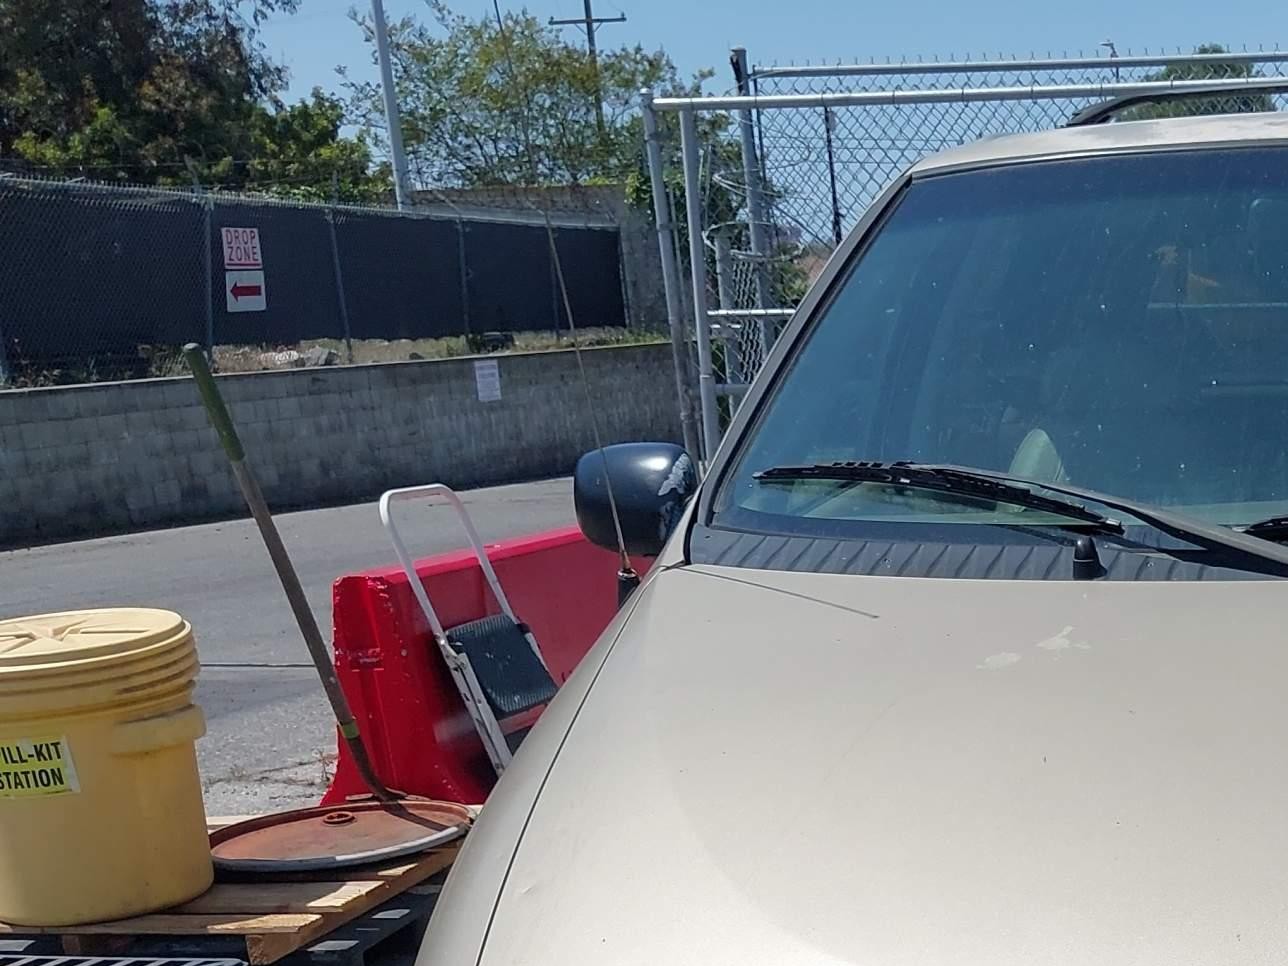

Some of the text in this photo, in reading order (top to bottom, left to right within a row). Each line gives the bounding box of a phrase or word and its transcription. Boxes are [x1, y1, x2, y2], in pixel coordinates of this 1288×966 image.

[225, 229, 256, 245] DROP
[227, 246, 259, 262] ZONE
[0, 742, 62, 764] ILL-KIT
